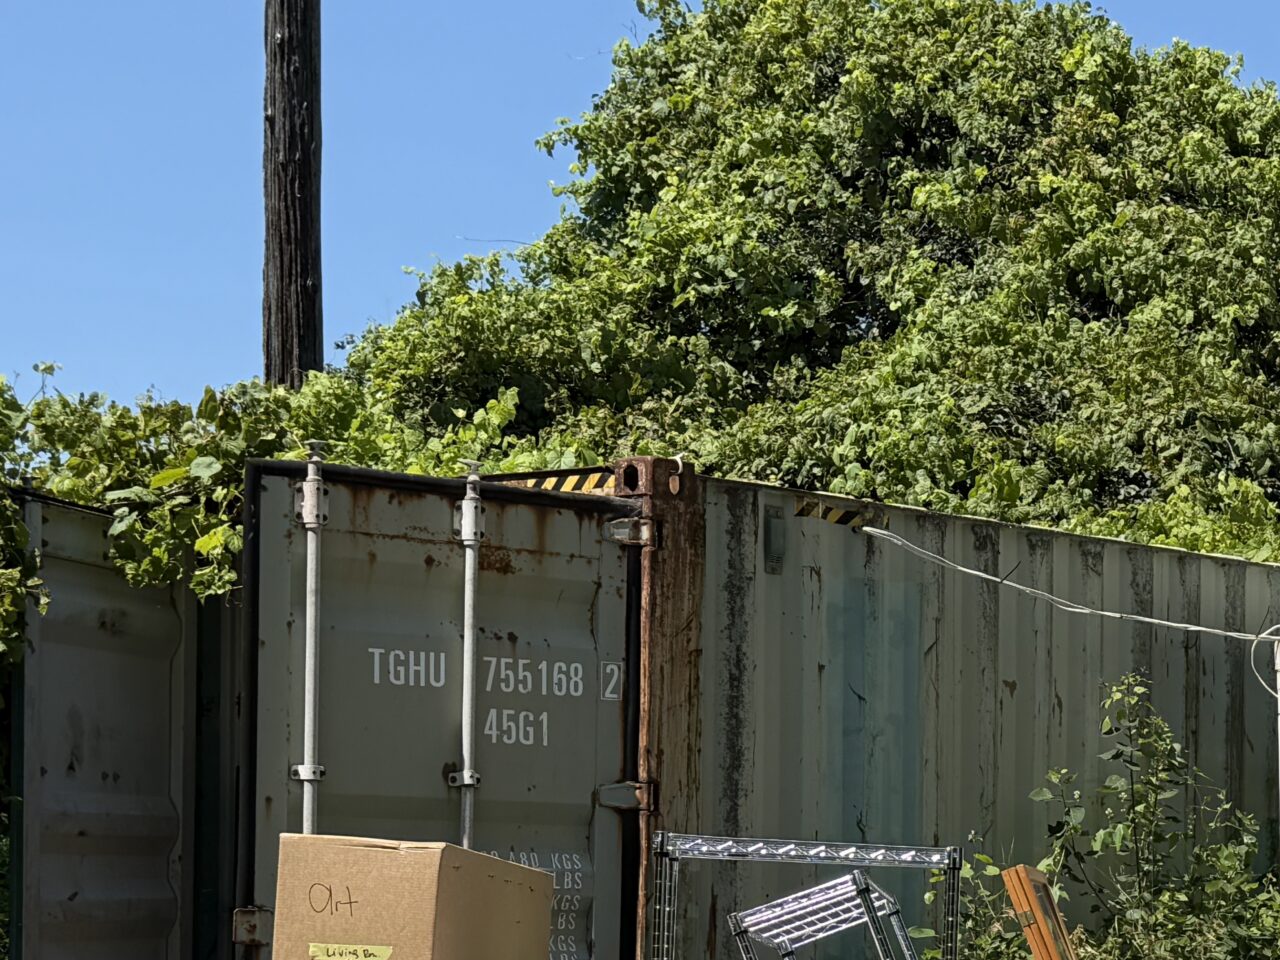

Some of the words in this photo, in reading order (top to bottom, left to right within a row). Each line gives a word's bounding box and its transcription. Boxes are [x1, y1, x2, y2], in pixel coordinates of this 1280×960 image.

[368, 648, 446, 688] TGHU
[483, 656, 583, 696] 755168
[604, 663, 620, 698] 2
[484, 708, 548, 746] 45G1
[551, 852, 582, 869] KGS
[553, 871, 582, 889] LBS
[550, 912, 577, 930] BS
